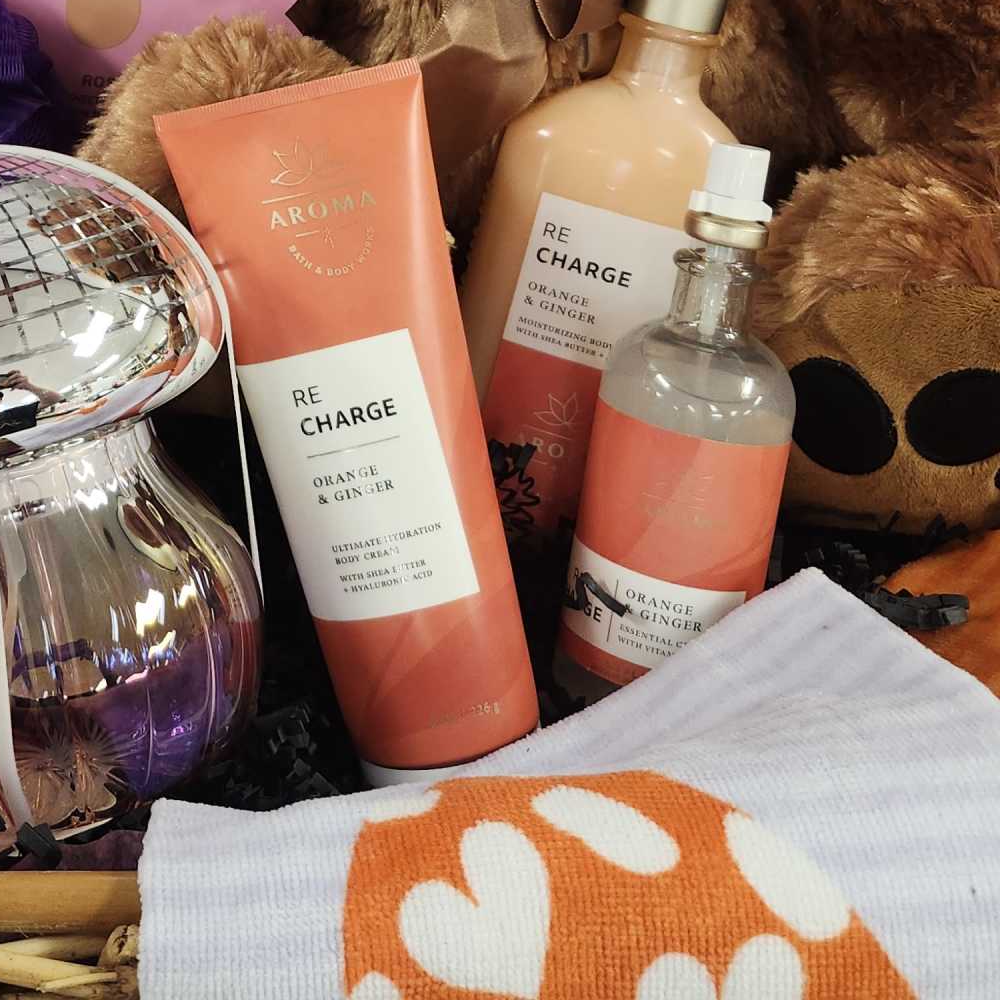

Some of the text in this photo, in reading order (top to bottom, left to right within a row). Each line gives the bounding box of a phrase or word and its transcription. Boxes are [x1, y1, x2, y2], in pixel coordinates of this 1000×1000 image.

[270, 190, 376, 229] AROMA
[543, 222, 571, 244] RE
[288, 244, 312, 269] BATH
[327, 263, 354, 276] BODY
[536, 246, 633, 288] CHARGE
[528, 280, 590, 307] ORANGE
[524, 295, 596, 325] & GINGER
[516, 326, 539, 340] WITH
[541, 335, 562, 347] SHEA
[518, 316, 588, 343] MOISTURIZING
[292, 385, 322, 408] RE
[300, 398, 398, 436] CHARGE
[313, 464, 378, 488] ORANGE
[318, 479, 394, 505] & GINGER
[331, 536, 382, 553] ULTIMATE
[335, 553, 361, 566] BODY
[339, 571, 364, 583] WITH
[366, 567, 390, 579] SHEA
[412, 569, 433, 581] ACID
[626, 588, 695, 616] ORANGE
[640, 609, 703, 633] GINGER
[617, 635, 643, 649] WITH
[619, 623, 673, 647] ESSENTIAL
